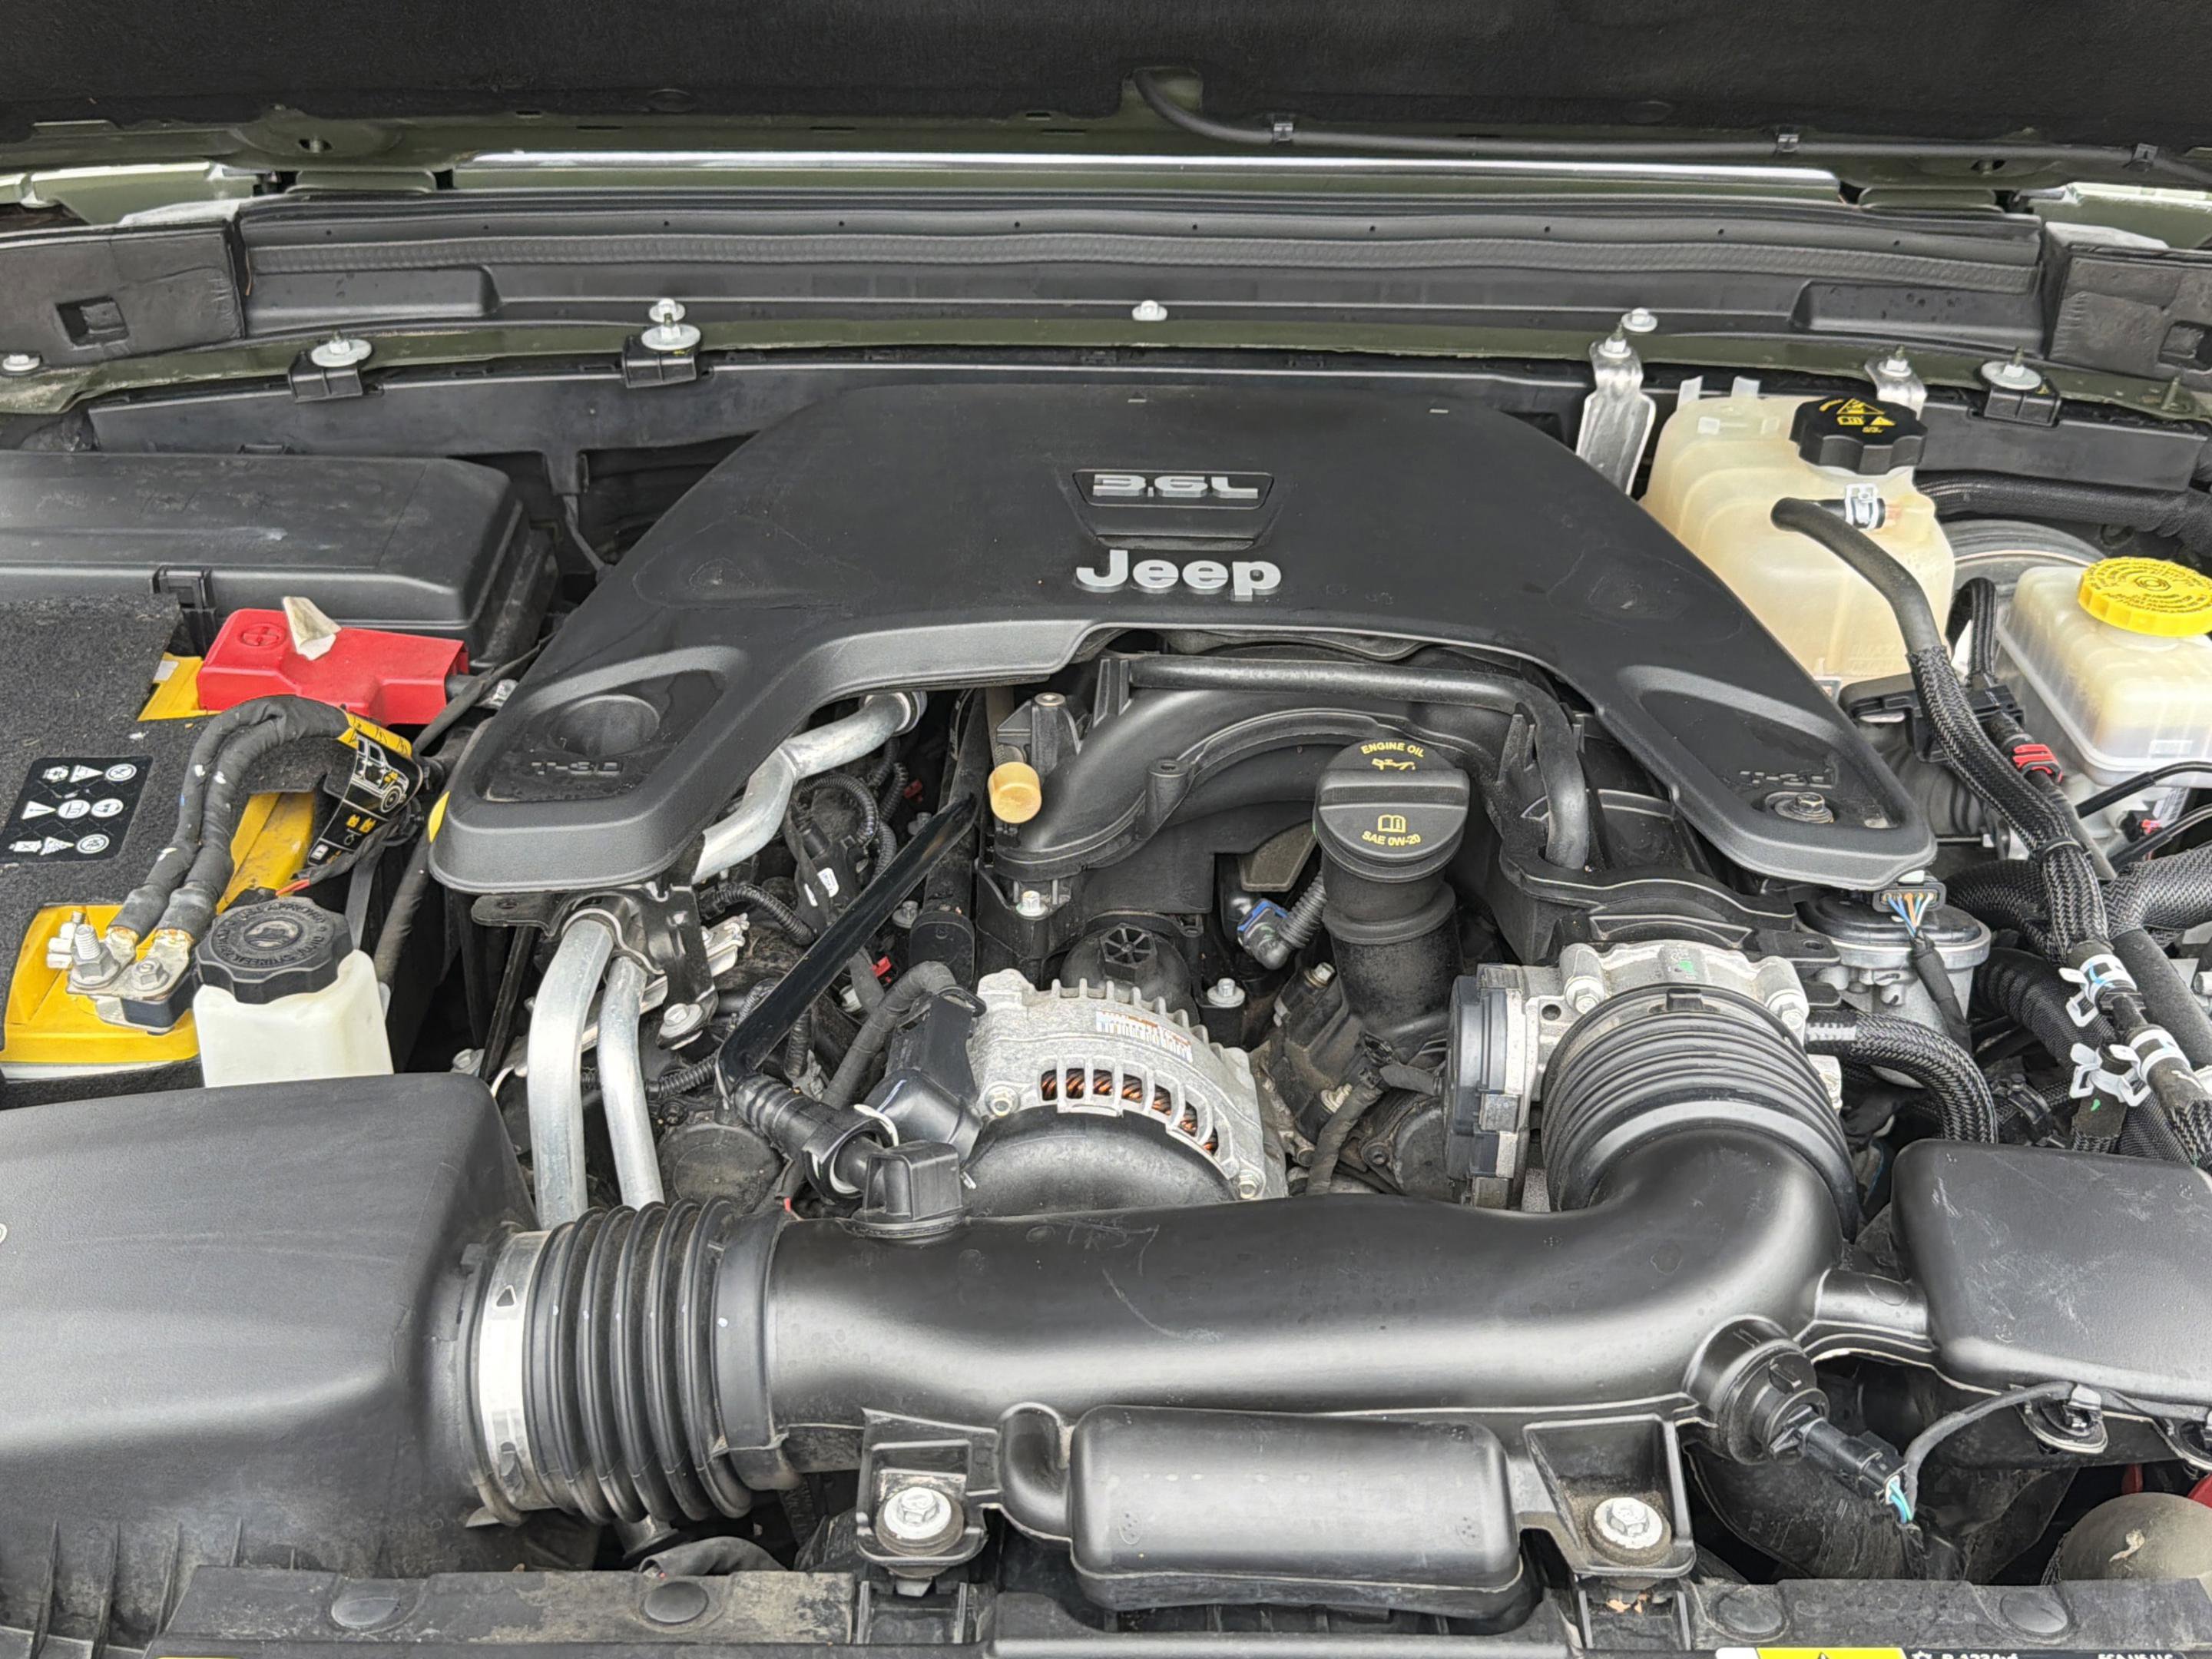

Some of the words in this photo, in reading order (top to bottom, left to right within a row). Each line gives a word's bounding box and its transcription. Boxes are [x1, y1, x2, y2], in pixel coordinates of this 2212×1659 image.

[1093, 474, 1259, 499] 3.6L
[1075, 549, 1282, 601] Jeep
[1361, 742, 1406, 754] ENGINE
[1407, 744, 1425, 757] OIL
[1363, 831, 1386, 845] SAE
[1388, 834, 1421, 846] 0W-20
